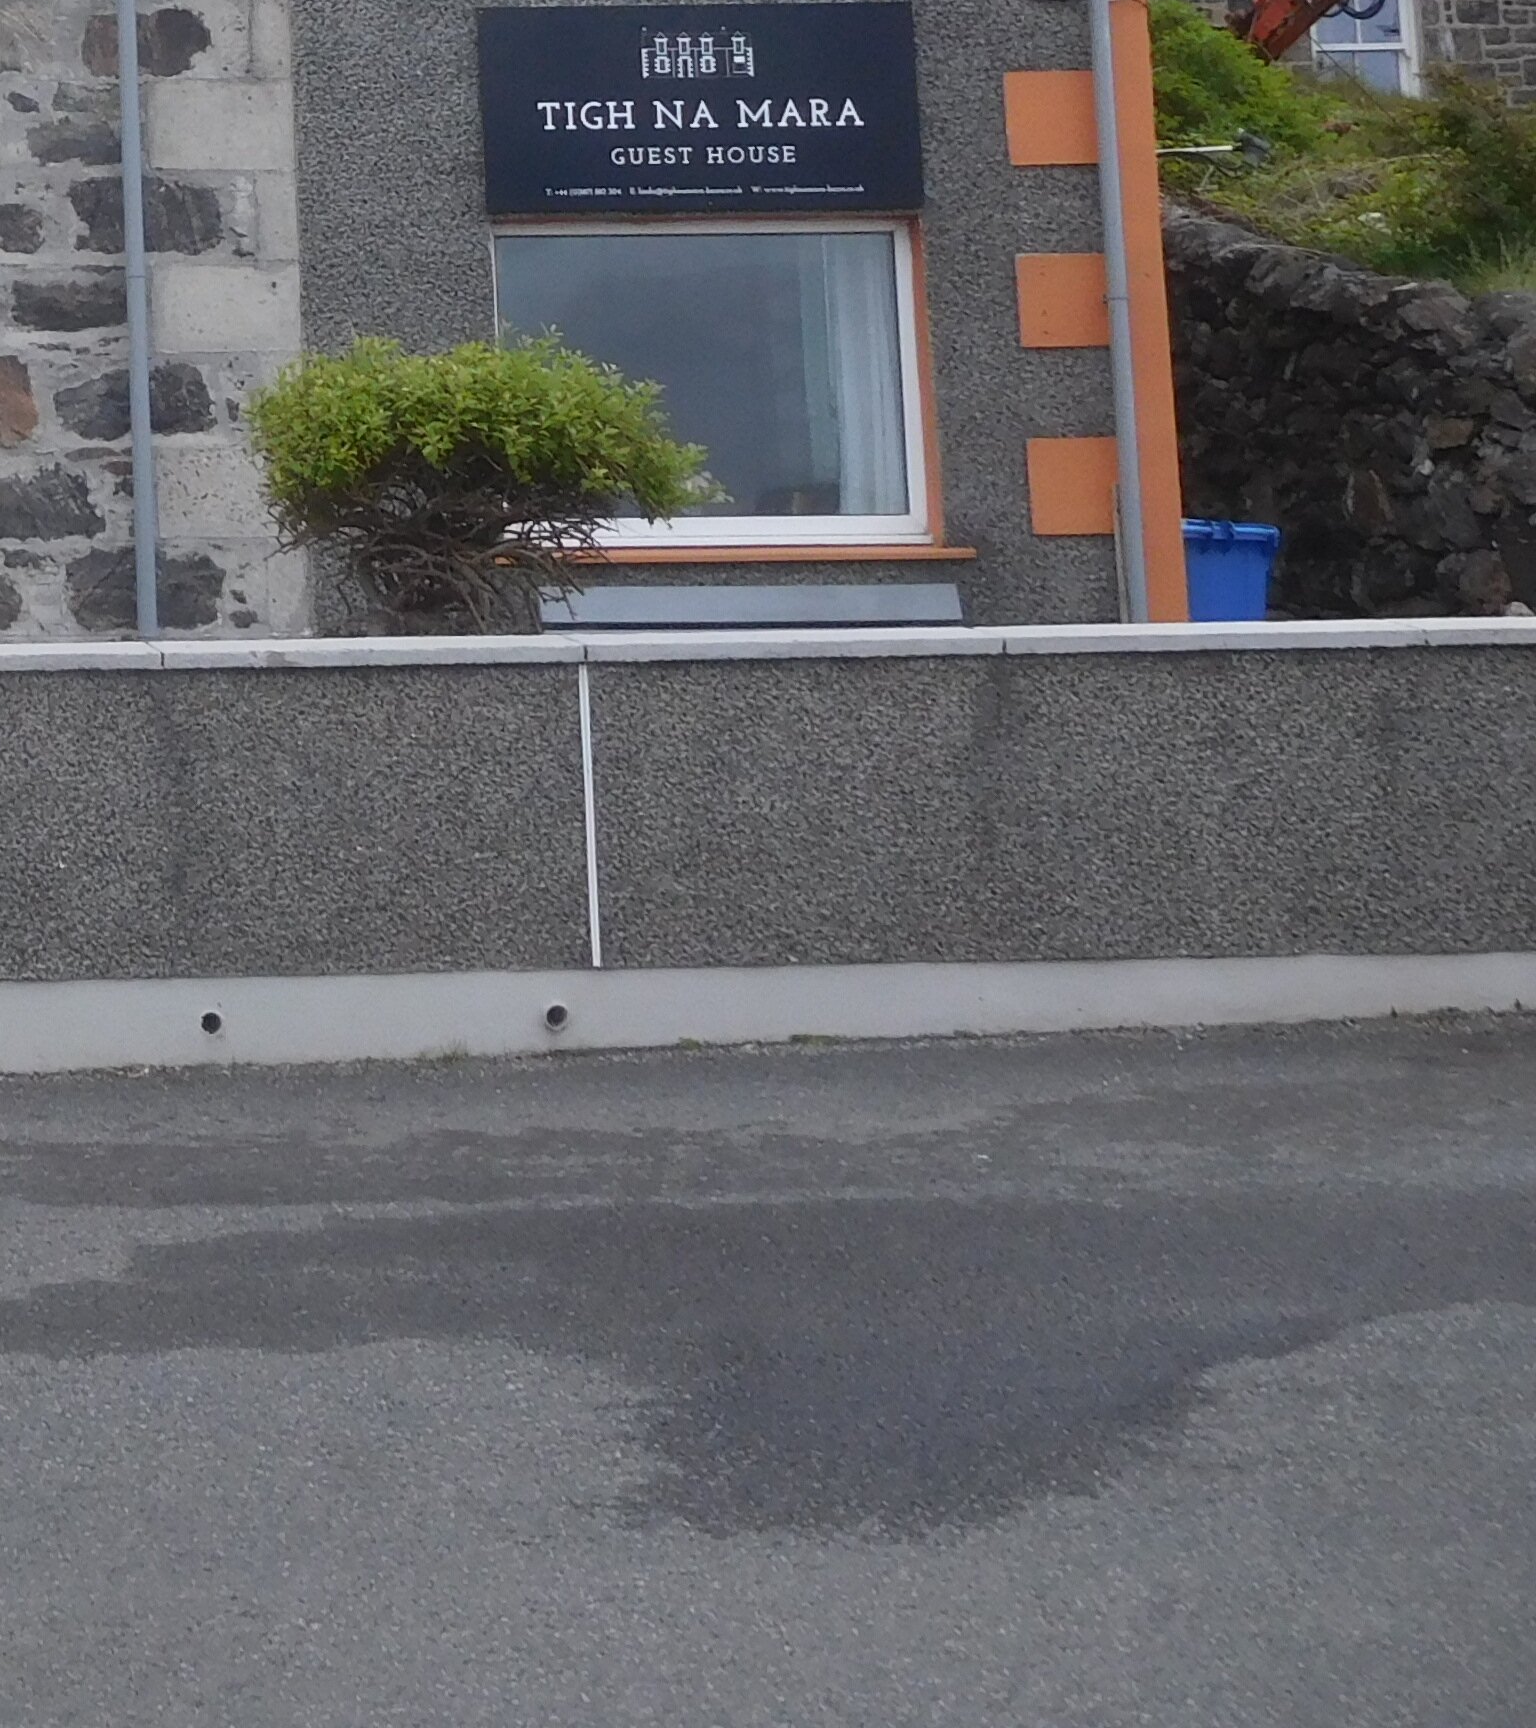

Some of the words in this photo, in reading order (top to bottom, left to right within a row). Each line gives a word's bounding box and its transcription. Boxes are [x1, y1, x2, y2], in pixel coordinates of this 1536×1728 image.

[537, 100, 636, 130] TIGH
[652, 99, 719, 129] NA
[735, 97, 865, 127] MARA
[610, 146, 693, 165] GUEST
[706, 145, 797, 164] HOUSE
